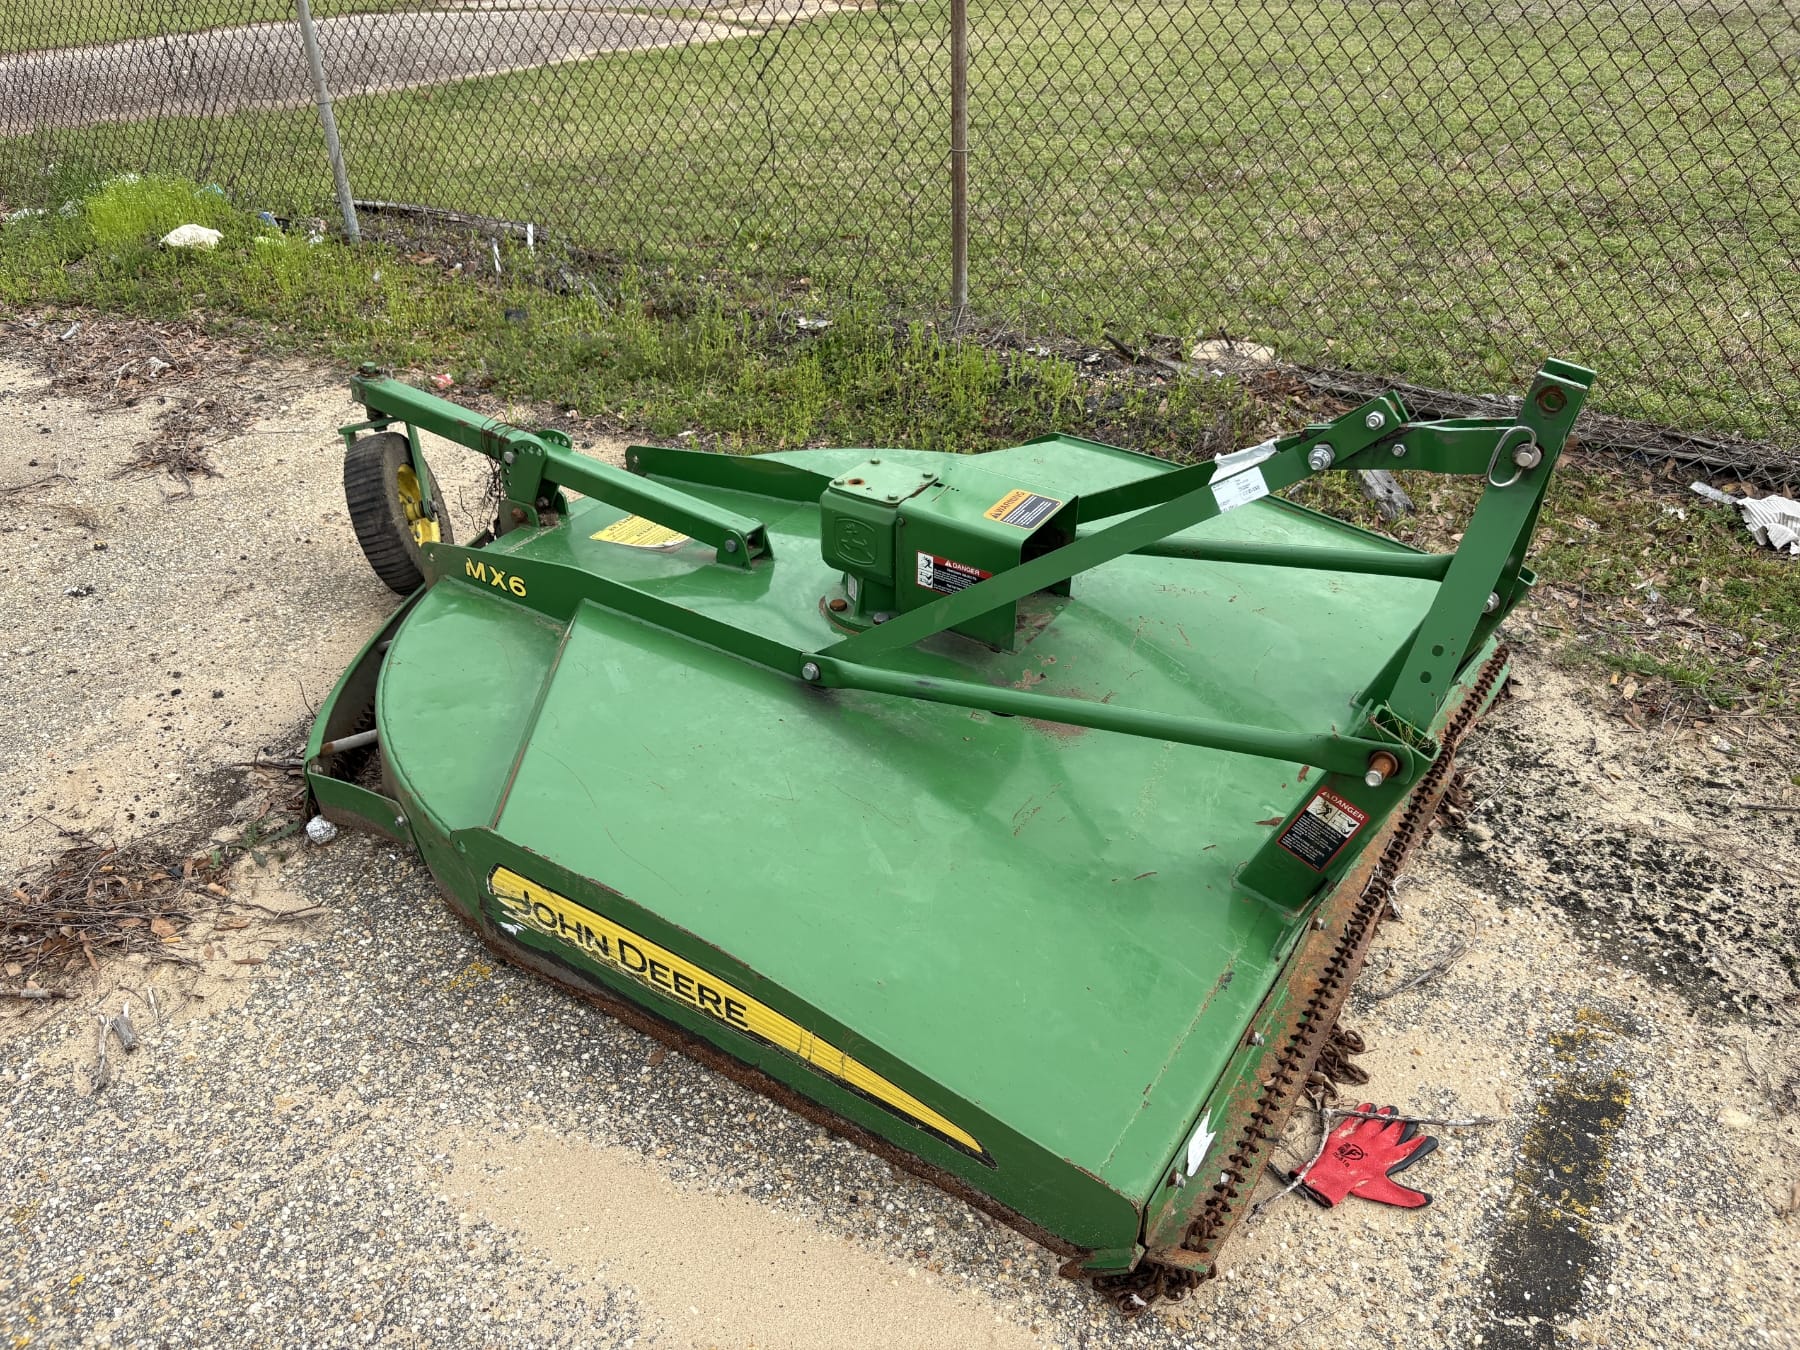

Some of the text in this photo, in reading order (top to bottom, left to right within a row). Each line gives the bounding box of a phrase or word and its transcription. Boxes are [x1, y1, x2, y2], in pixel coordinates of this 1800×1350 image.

[996, 491, 1025, 515] WARNING
[465, 556, 527, 598] MX6
[952, 562, 980, 576] DANGER
[1330, 795, 1365, 821] DANGER
[515, 890, 749, 1028] JOHN DEERE
